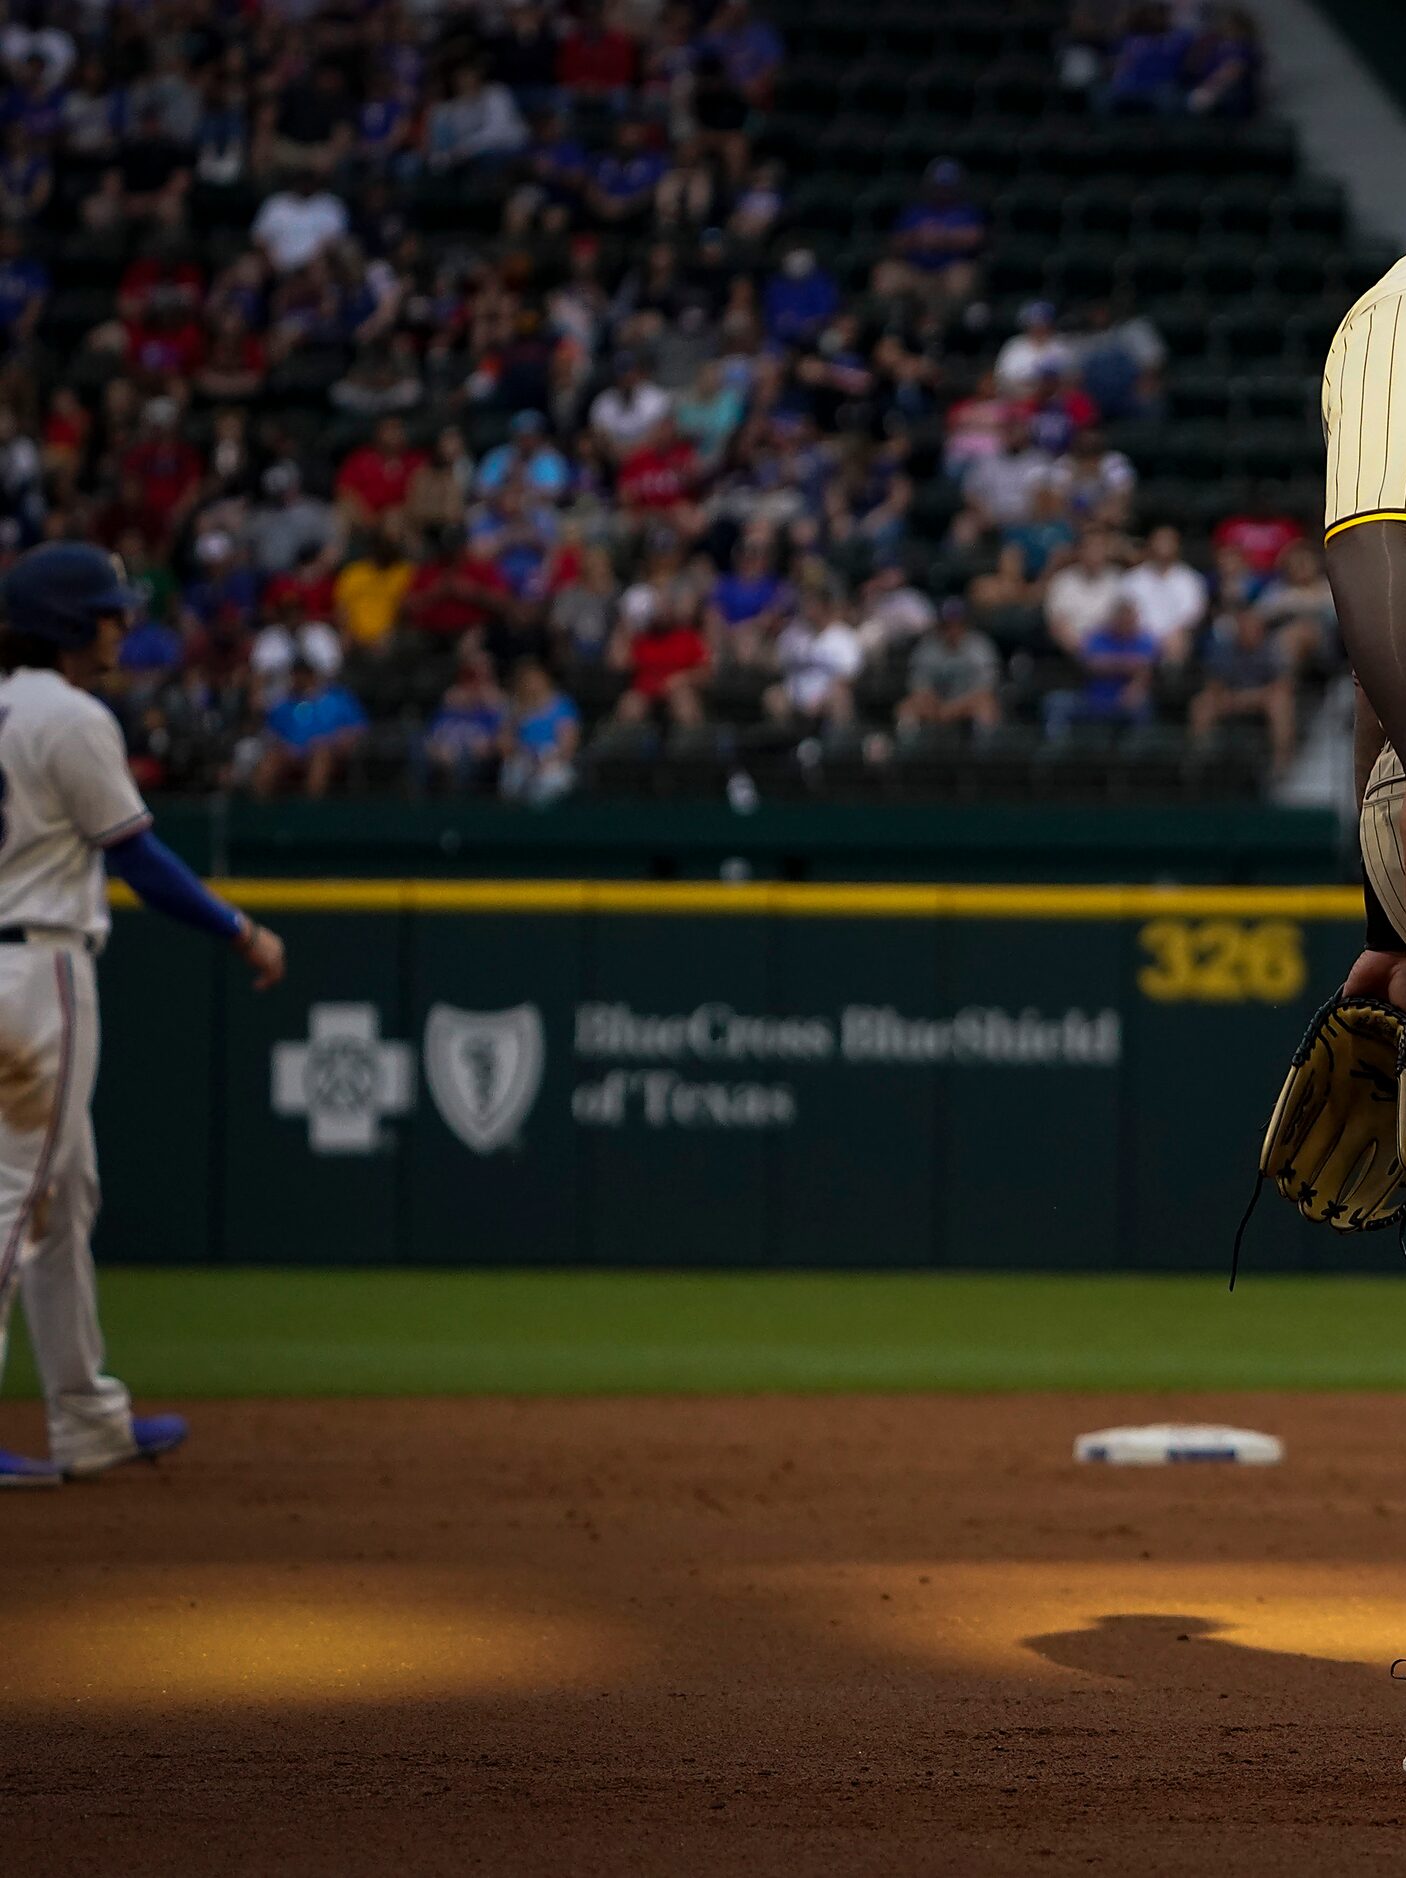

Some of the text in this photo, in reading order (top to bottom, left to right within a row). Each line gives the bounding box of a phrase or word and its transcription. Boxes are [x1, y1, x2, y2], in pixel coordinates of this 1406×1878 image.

[1137, 920, 1304, 1003] 326
[574, 1002, 1121, 1066] BlueCross BlueShield
[571, 1069, 795, 1128] of Texas
